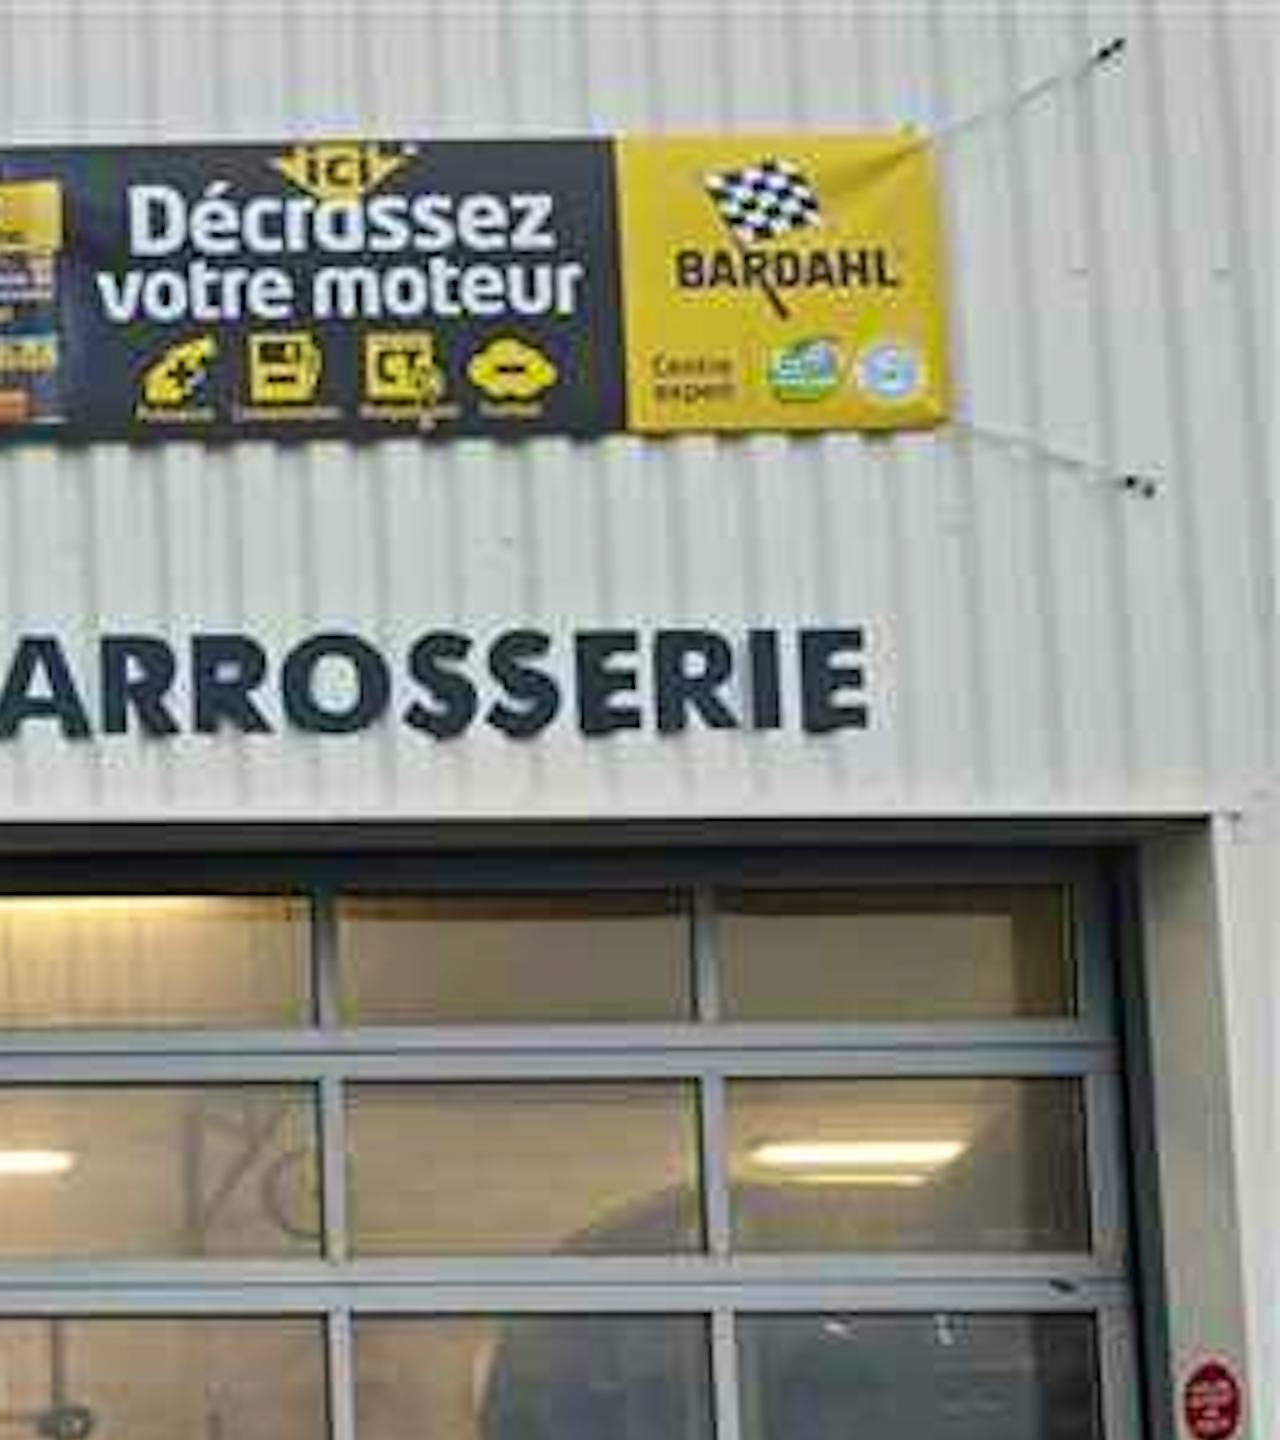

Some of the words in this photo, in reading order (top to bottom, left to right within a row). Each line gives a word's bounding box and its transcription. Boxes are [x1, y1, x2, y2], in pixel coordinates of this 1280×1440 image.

[127, 180, 557, 256] Décrassez
[96, 259, 294, 321] votre
[312, 257, 584, 317] moteur
[676, 250, 899, 288] BARDAHL
